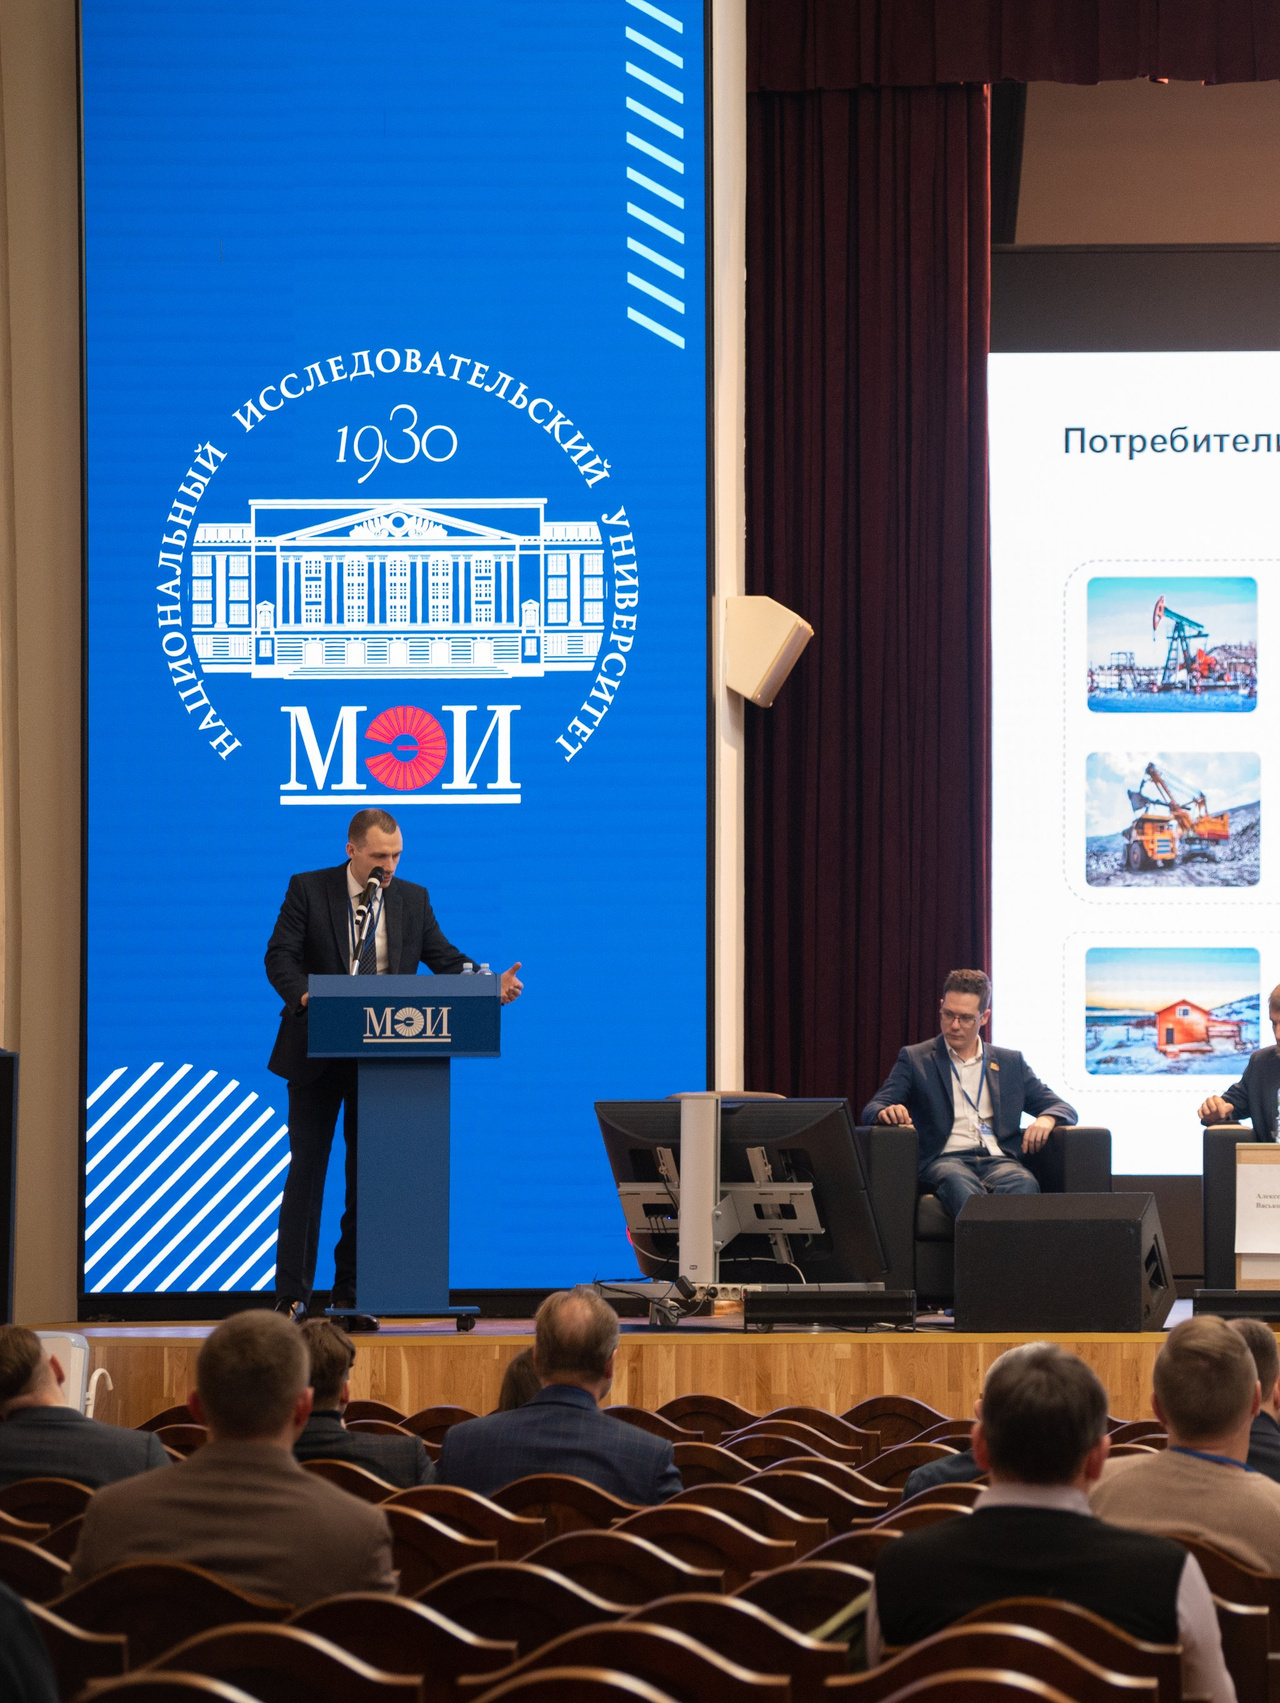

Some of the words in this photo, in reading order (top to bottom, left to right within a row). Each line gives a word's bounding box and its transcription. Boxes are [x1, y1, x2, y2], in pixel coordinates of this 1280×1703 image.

[336, 403, 458, 484] 1930
[157, 440, 242, 760] НАЦИОНАЛЬНЫЙ
[232, 348, 611, 488] ИССЛЕДОВАТЕЛЬСКИЙ
[555, 505, 639, 762] УНИВЕРСИТЕТ
[280, 704, 521, 791] МЭИ
[363, 1007, 452, 1037] МЭИ
